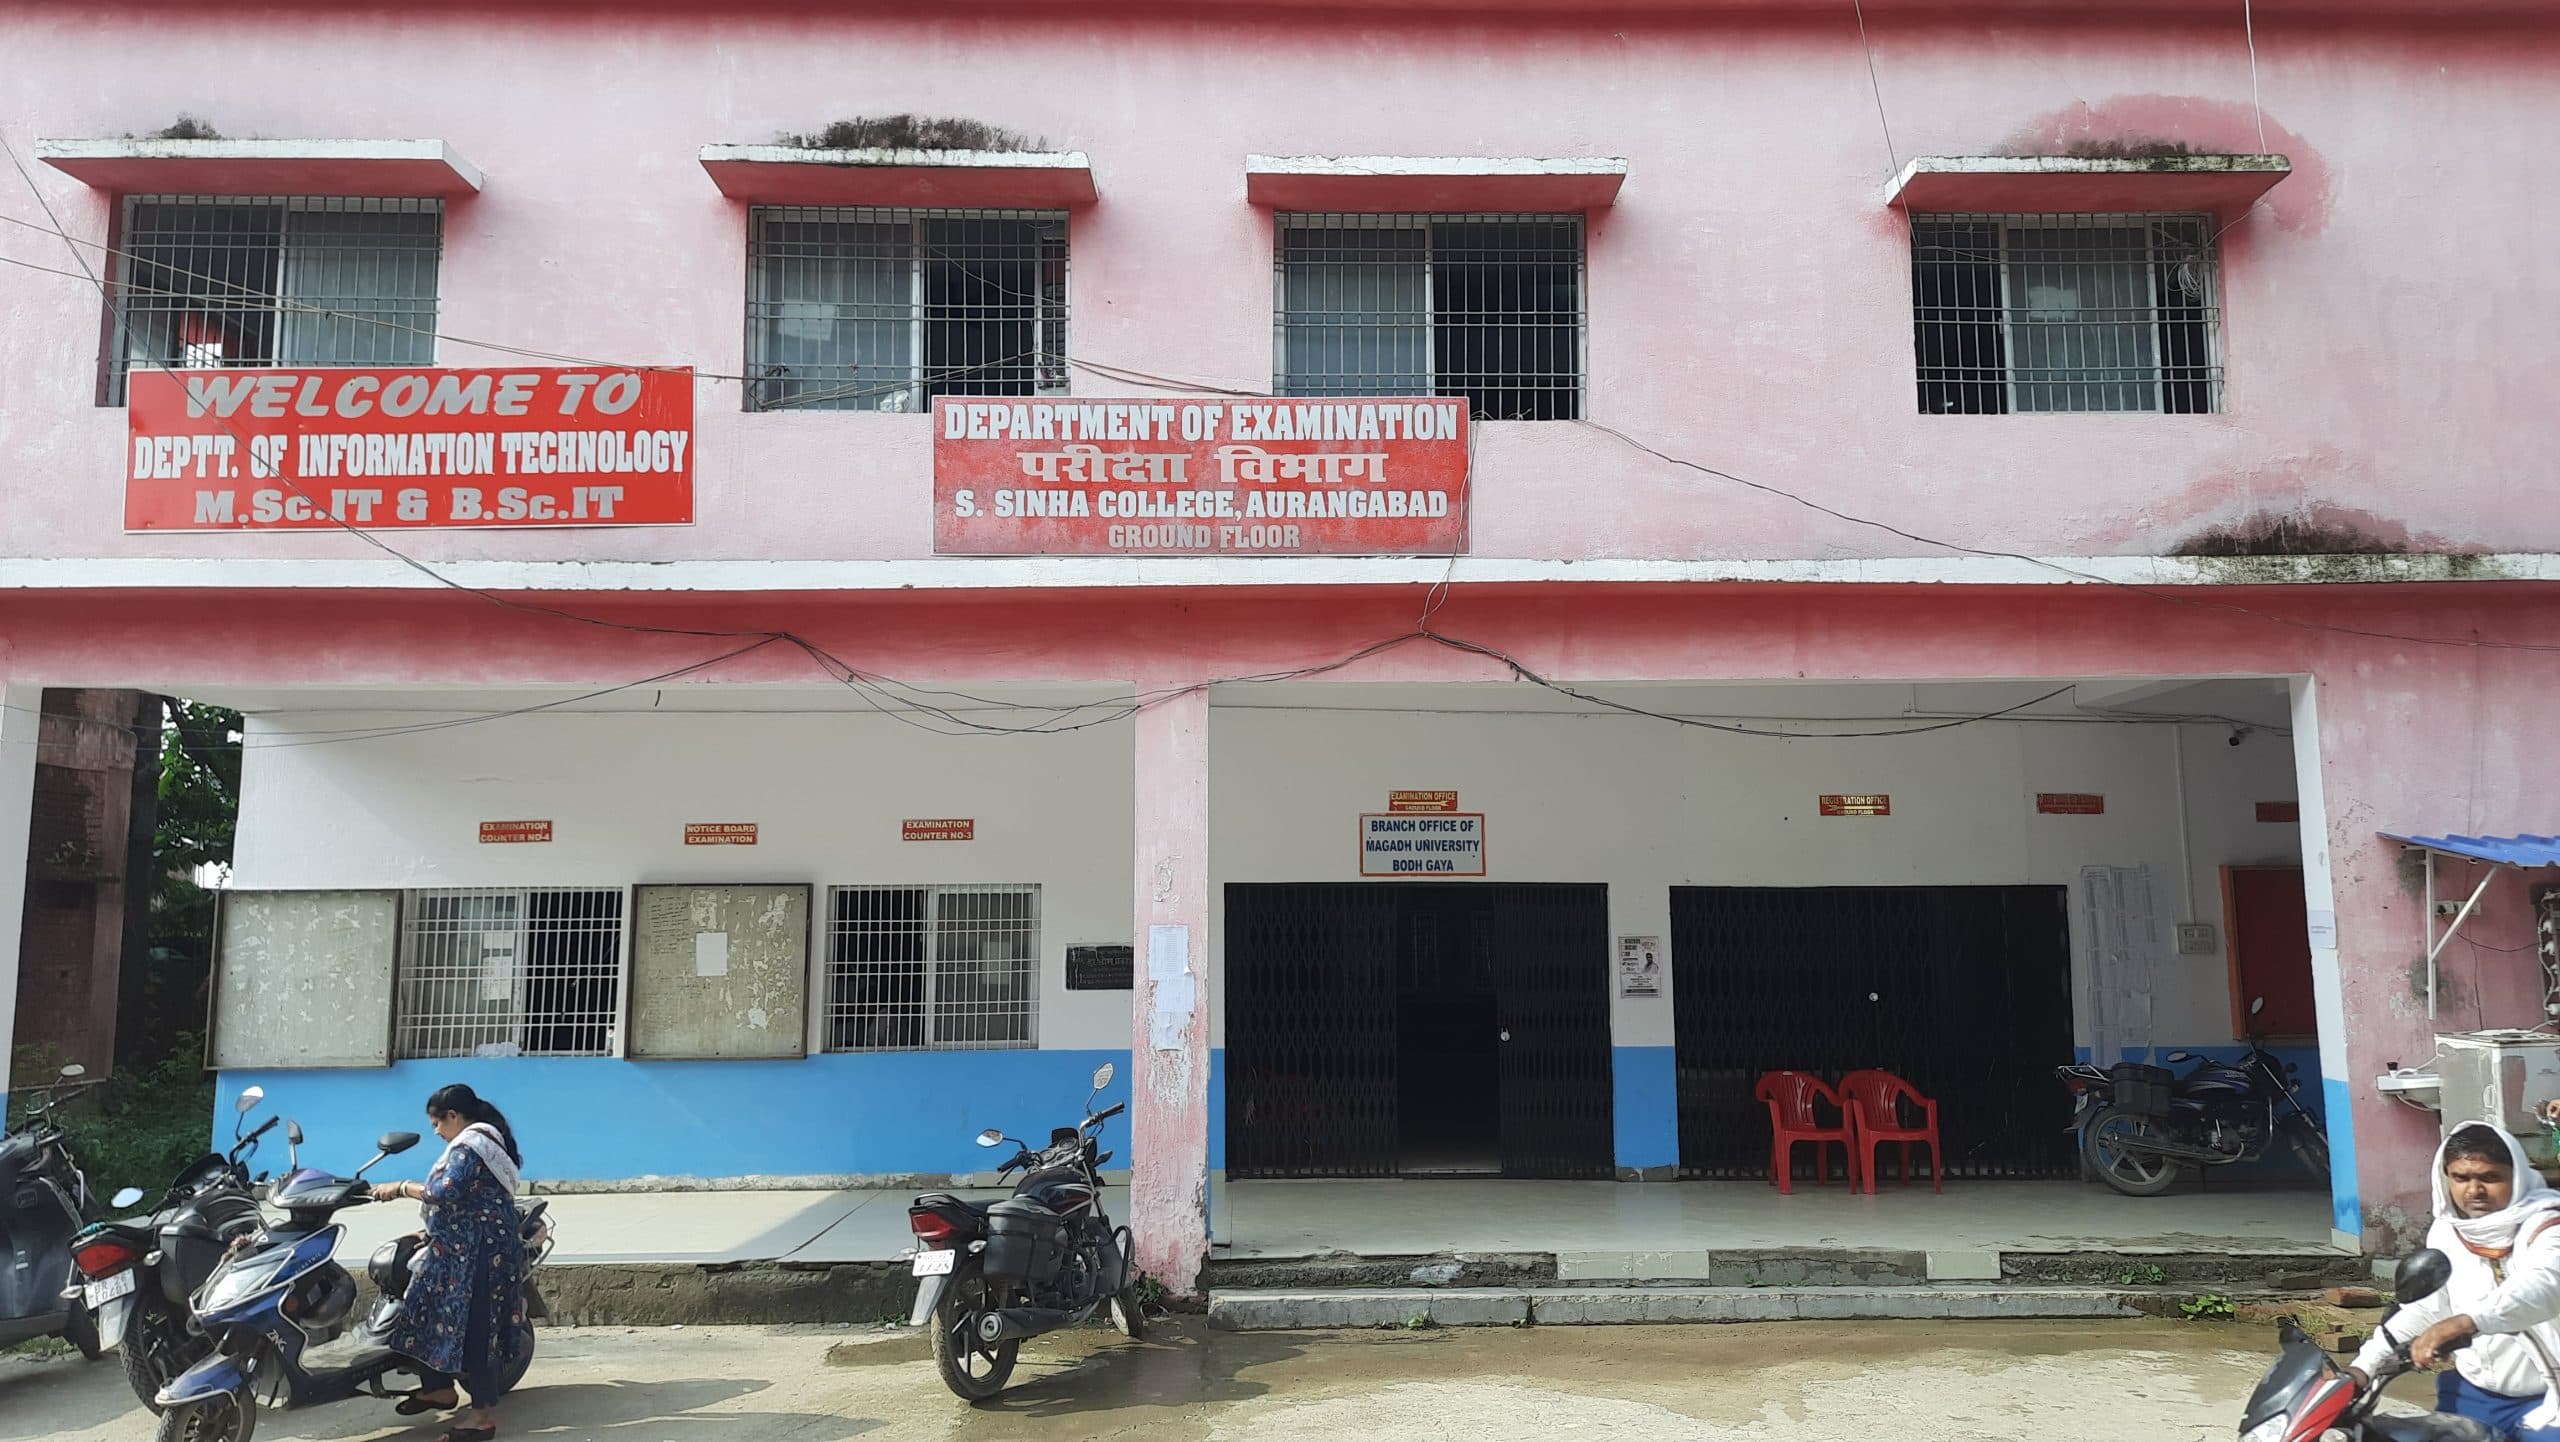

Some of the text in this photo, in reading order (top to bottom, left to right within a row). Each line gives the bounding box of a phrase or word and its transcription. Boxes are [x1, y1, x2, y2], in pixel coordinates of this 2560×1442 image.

[185, 373, 641, 418] WELCOME TO
[945, 404, 1457, 441] DEPARTMENT OF EXAMINATION
[133, 429, 689, 479] DEPTT. OF INFORMATION TECHNOLOGY
[1016, 444, 1389, 483] परीक्षा विभाग
[396, 488, 430, 521] &
[955, 491, 984, 518] S.
[994, 490, 1090, 518] SINHA
[1108, 524, 1300, 549] GROUND FLOOR
[1392, 792, 1456, 800] EXAMINATION OFFICE
[482, 822, 548, 831] EXAMINATION
[687, 825, 756, 833] NOTICE BOARD
[906, 821, 970, 829] EXAMINATION
[1371, 820, 1474, 832] BRANCH OFFICE OF
[481, 833, 526, 842] COUNTER
[688, 836, 753, 844] EXAMINATION
[904, 832, 948, 840] COUNTER
[1366, 840, 1480, 852] MAGADH UNIVERSITY
[1392, 859, 1454, 872] BODH GAYA
